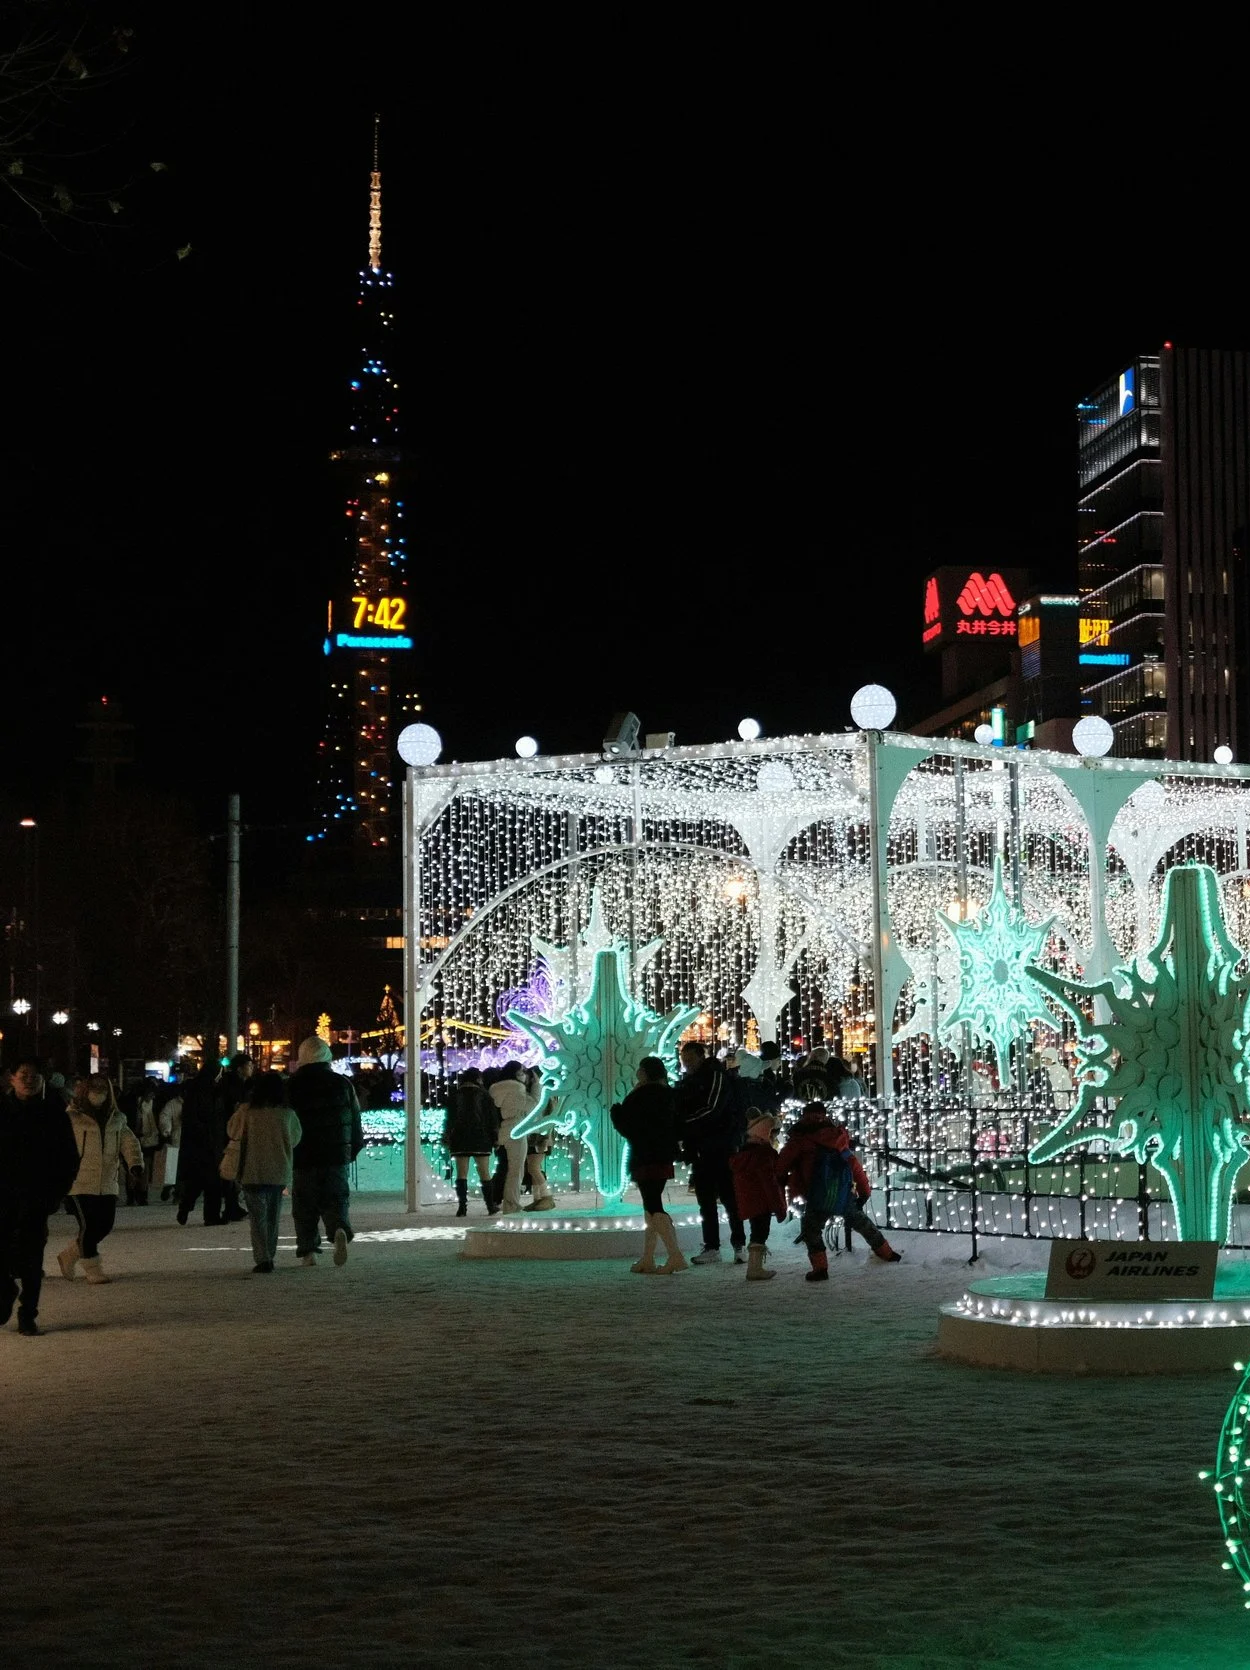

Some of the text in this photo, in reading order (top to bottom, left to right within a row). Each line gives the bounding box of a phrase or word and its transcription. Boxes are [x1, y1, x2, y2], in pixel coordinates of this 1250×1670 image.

[351, 596, 406, 630] 7:42
[956, 619, 1017, 636] 丸井今井
[336, 633, 414, 649] Panasonic
[1104, 1251, 1169, 1263] JAPAN
[1106, 1265, 1201, 1277] AIRLINES
